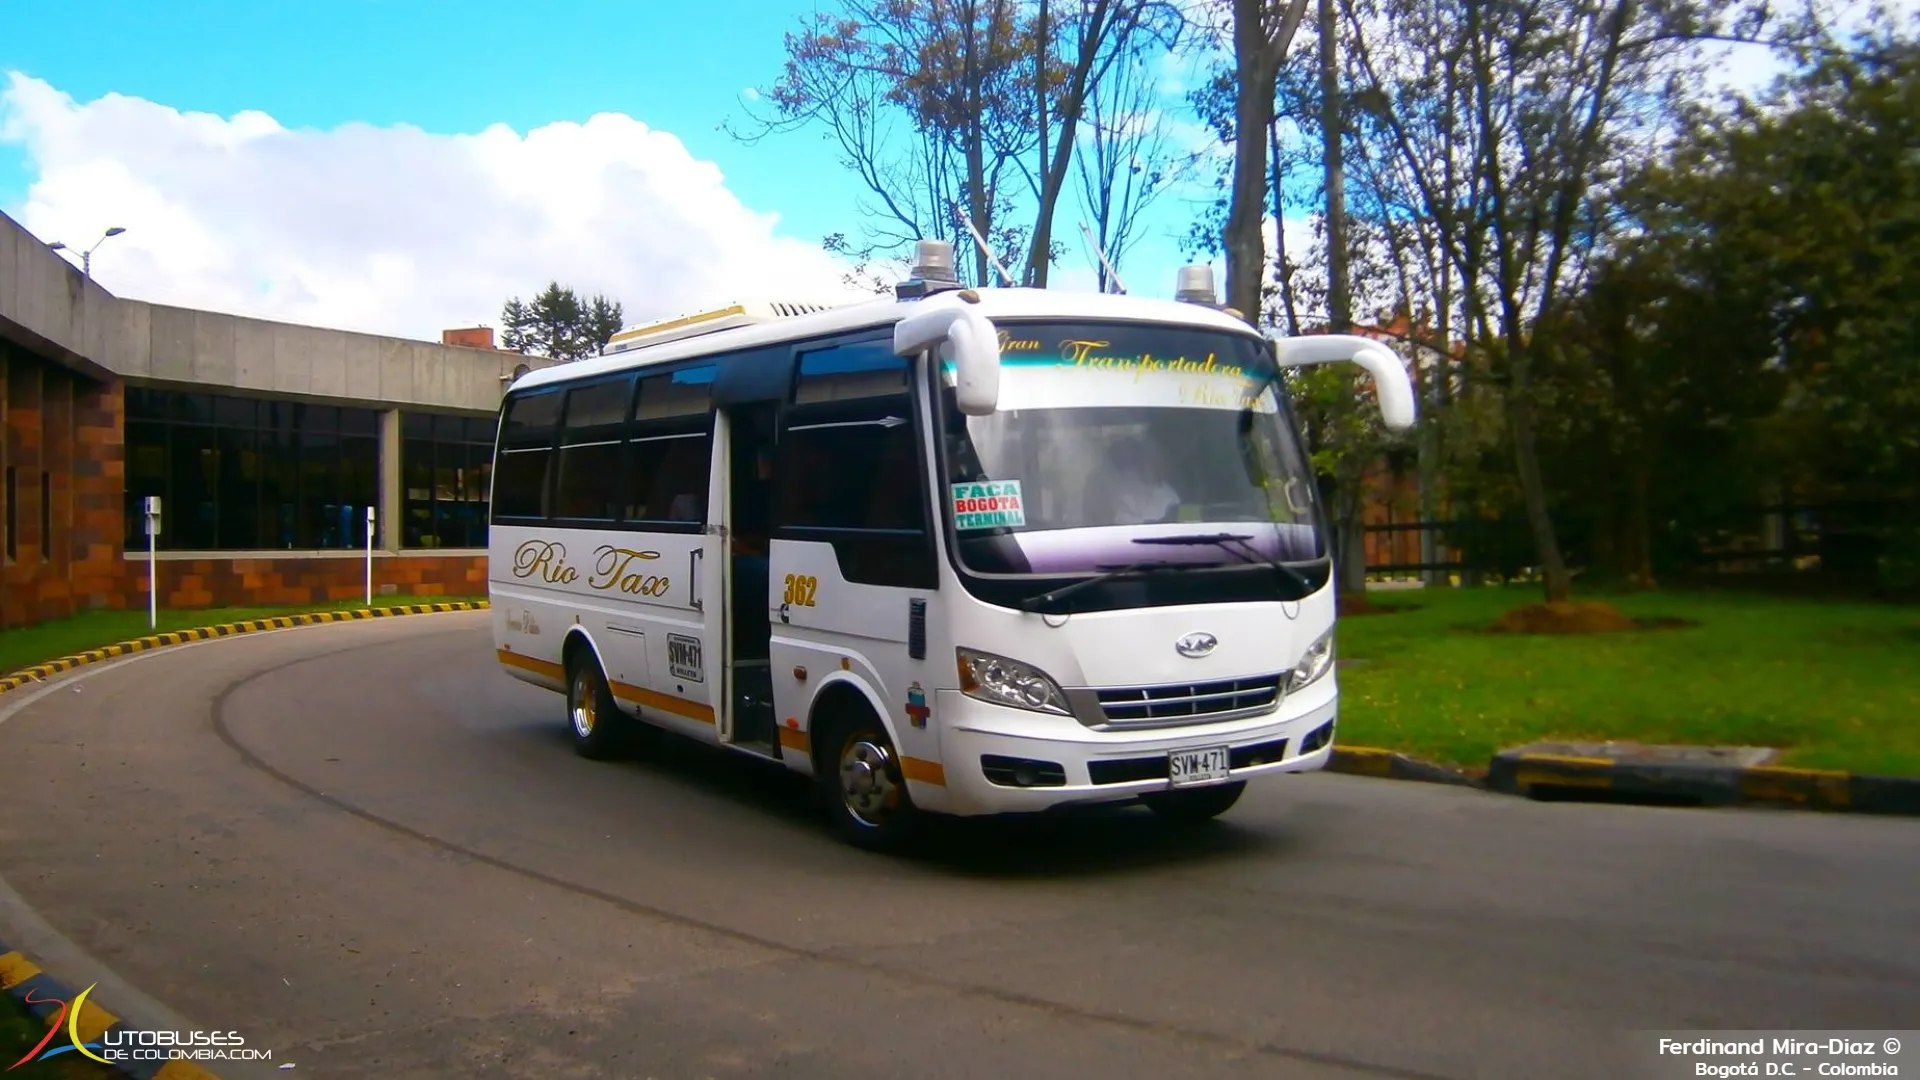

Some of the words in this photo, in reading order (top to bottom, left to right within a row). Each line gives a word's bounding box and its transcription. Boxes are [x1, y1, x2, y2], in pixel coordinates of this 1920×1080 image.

[954, 483, 1018, 499] FACA
[956, 496, 1020, 513] BOGOTA
[956, 511, 1023, 527] TERMINAL
[512, 539, 580, 585] Rio
[588, 544, 671, 598] Tax
[784, 573, 818, 607] 362
[1172, 750, 1227, 776] SVM-471
